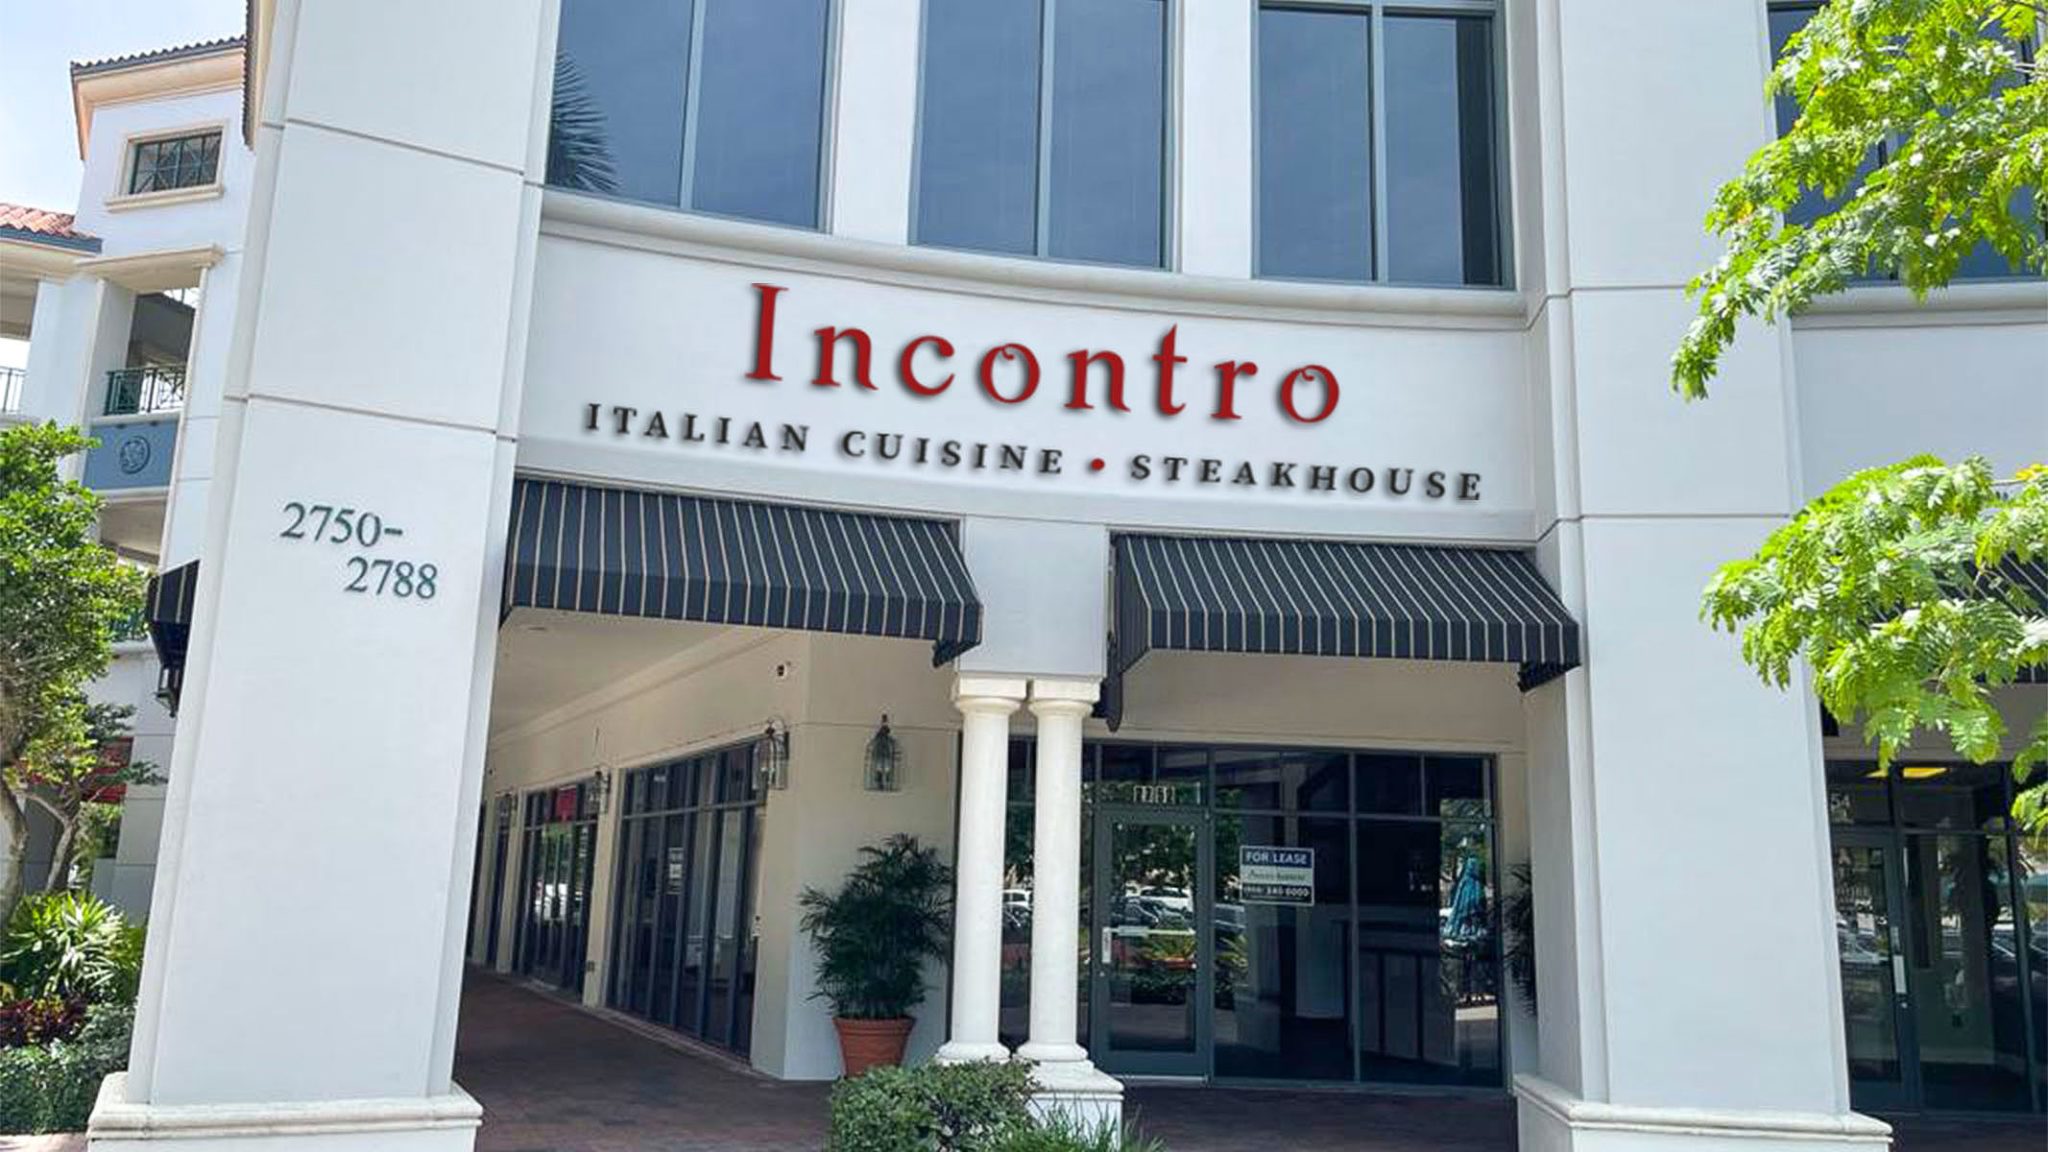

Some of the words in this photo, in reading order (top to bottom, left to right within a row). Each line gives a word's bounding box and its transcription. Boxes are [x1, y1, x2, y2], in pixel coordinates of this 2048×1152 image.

[745, 283, 1340, 423] Incontro
[586, 403, 807, 452] ITALIAN
[841, 431, 1062, 474] CUISINE
[1131, 455, 1481, 501] STEAKHOUSE
[281, 502, 403, 548] 2750-
[346, 556, 438, 600] 2788
[1246, 851, 1269, 863] FOR
[1273, 852, 1308, 864] LEASE
